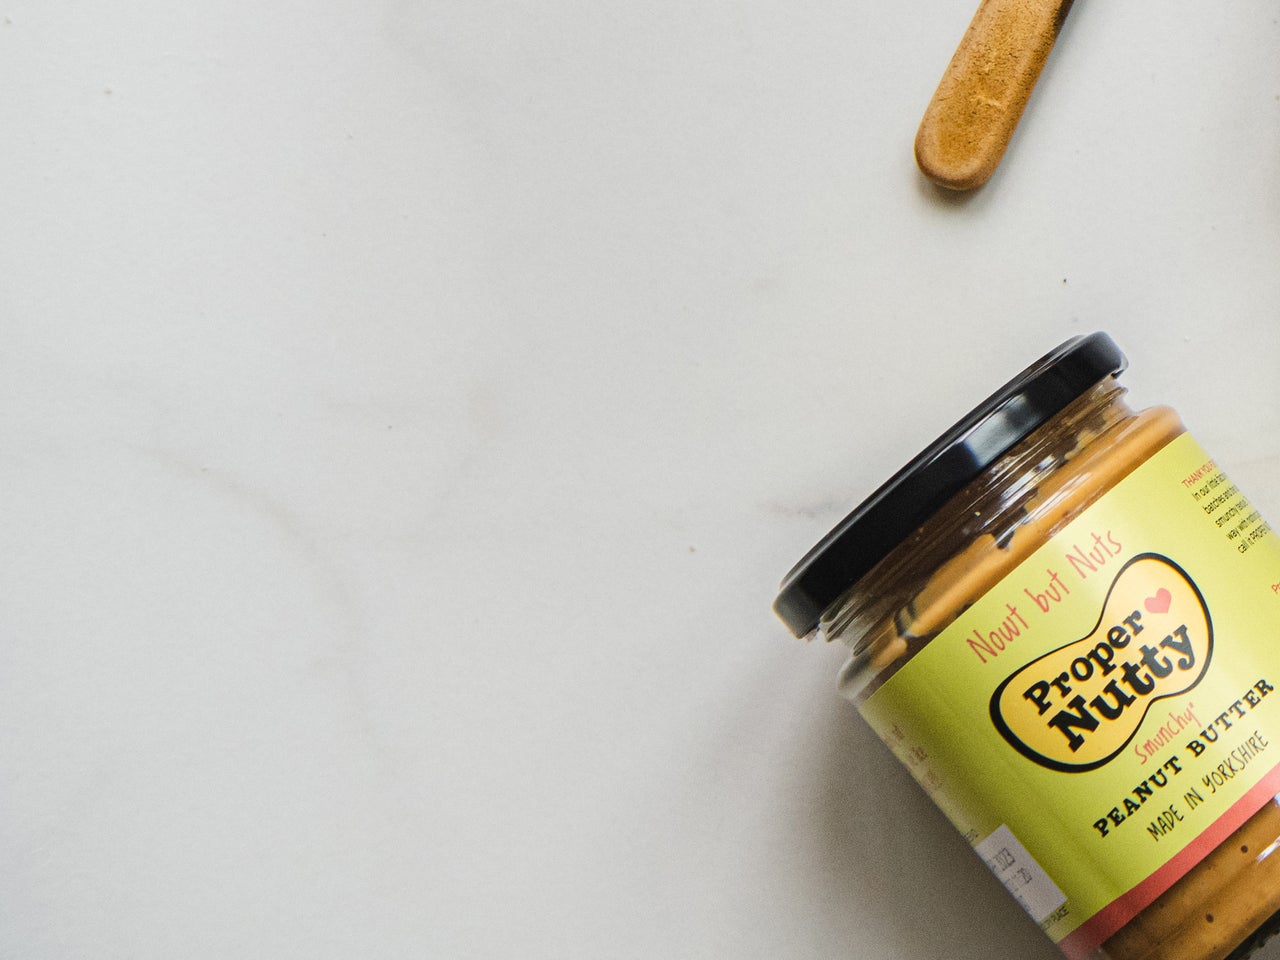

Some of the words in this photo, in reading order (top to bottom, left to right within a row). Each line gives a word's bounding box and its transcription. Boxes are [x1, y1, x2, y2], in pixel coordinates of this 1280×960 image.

[1200, 485, 1210, 496] our
[1226, 528, 1241, 540] way
[966, 603, 1029, 664] Nowt
[1024, 569, 1070, 613] but
[1065, 530, 1123, 579] Nuts
[1022, 610, 1144, 716] Proper
[1047, 624, 1195, 753] Nutty
[1092, 755, 1183, 838] PEANUT
[1185, 678, 1275, 758] BUTTER
[1146, 804, 1185, 842] MADE
[1183, 787, 1204, 811] IN
[1201, 730, 1269, 794] YORKSHIRE
